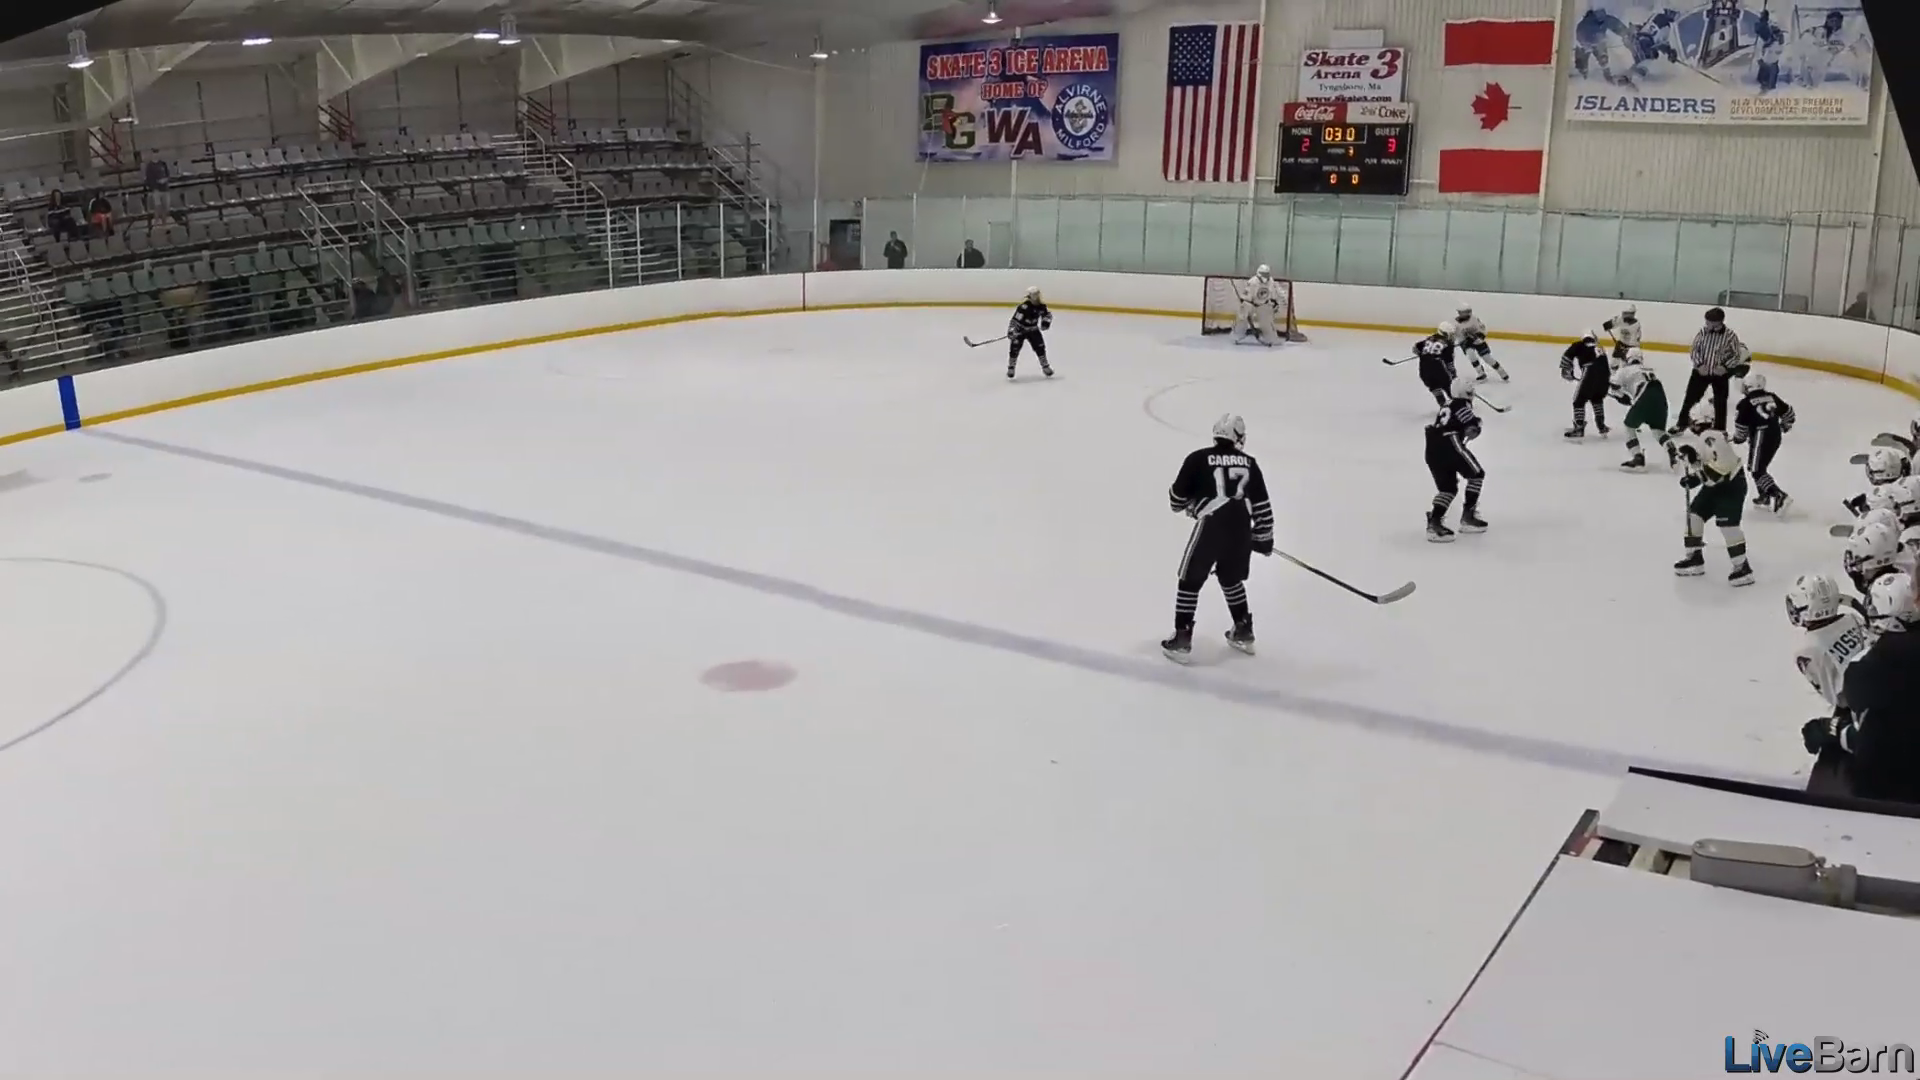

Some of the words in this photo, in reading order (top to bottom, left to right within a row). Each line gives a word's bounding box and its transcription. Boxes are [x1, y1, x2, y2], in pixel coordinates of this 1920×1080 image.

[927, 51, 984, 80] SKATE
[988, 50, 1002, 76] 3
[1005, 48, 1039, 75] ICE
[1042, 45, 1109, 73] ARENA
[1304, 51, 1370, 67] Skate
[1370, 49, 1402, 80] 3
[1311, 69, 1361, 80] Arena
[981, 82, 1024, 99] HOME
[1029, 81, 1048, 98] OF
[1055, 84, 1107, 114] ALVIRNE
[1378, 106, 1406, 119] Coke
[1574, 95, 1716, 115] ISLANDERS
[985, 106, 1043, 158] WA
[1056, 122, 1105, 150] MILFORD
[1291, 127, 1313, 136] HOME
[1375, 127, 1401, 136] GUEST
[1301, 138, 1310, 152] 2
[1387, 138, 1397, 153] 3
[1352, 173, 1359, 184] 0
[1213, 467, 1250, 500] 17
